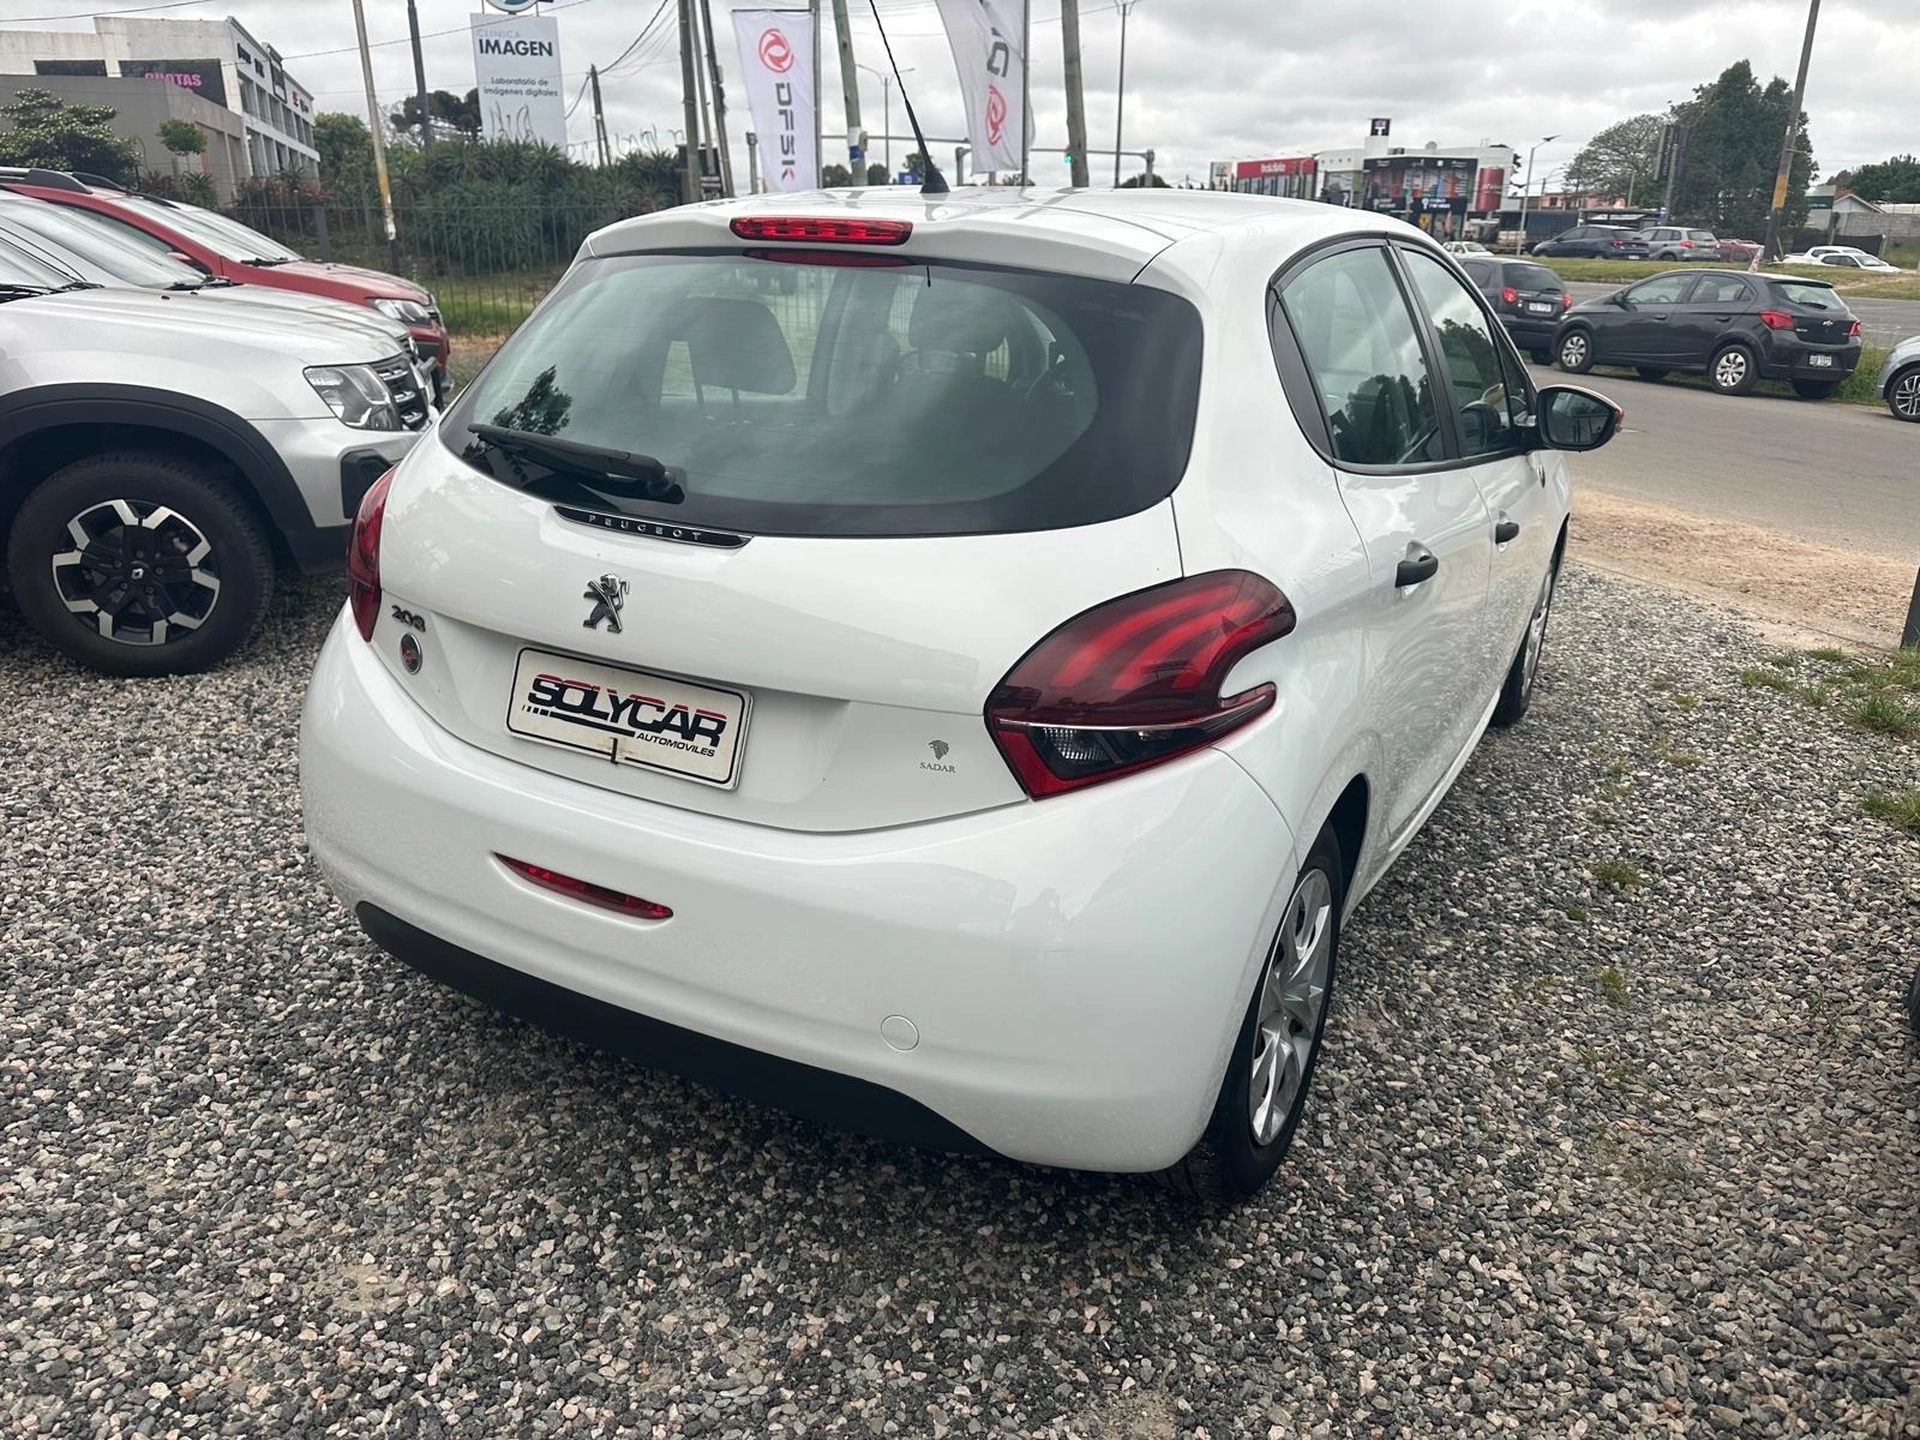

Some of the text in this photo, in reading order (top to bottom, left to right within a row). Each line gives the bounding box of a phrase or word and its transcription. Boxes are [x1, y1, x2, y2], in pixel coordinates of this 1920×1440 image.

[479, 39, 553, 56] IMAGEN
[491, 77, 536, 86] Laboratorio
[525, 87, 558, 97] digitales
[588, 513, 702, 541] PEUGEOT
[391, 604, 427, 633] 208
[528, 673, 728, 749] SOLYCAR
[636, 732, 716, 758] AUTOMOVILES
[919, 761, 956, 773] SADAR
